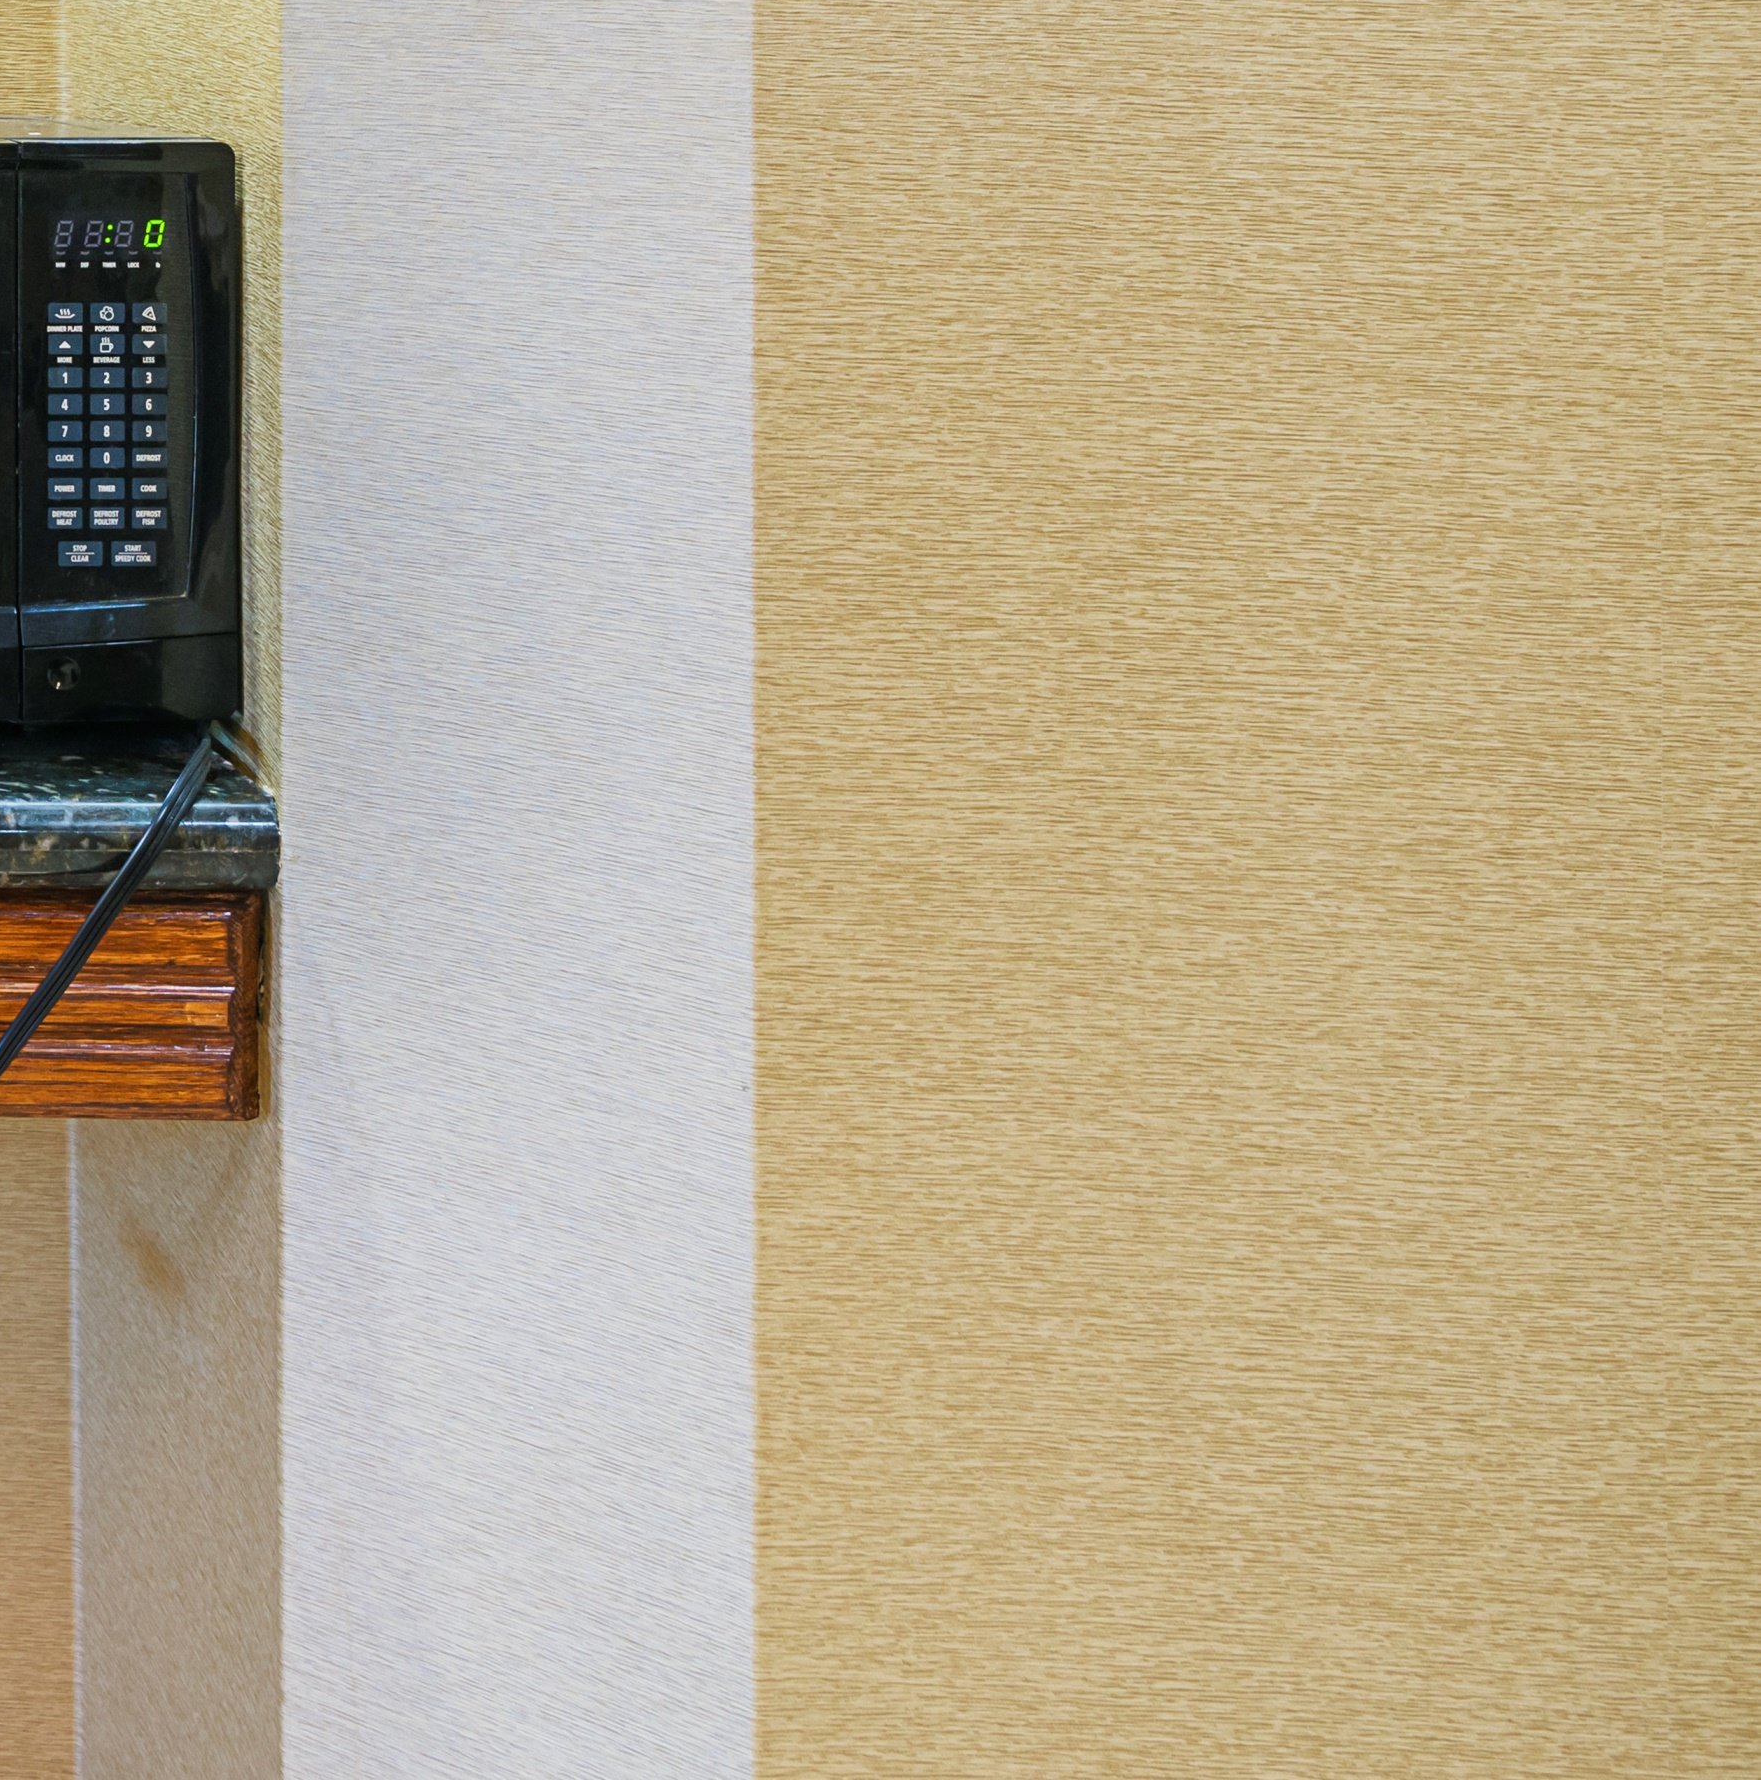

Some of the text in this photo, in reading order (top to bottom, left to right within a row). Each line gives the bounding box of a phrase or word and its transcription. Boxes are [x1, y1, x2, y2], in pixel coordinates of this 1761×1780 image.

[94, 325, 120, 333] POPCORN
[141, 325, 157, 333] PIZZA
[57, 356, 73, 364] MORE
[93, 356, 120, 364] BEVERAGE
[142, 356, 155, 364] LESS
[62, 372, 68, 384] 1
[103, 372, 110, 384] 2
[145, 372, 153, 385] 3
[61, 398, 69, 411] 4
[103, 398, 110, 411] 5
[145, 398, 153, 411] 6
[61, 425, 69, 438] 7
[103, 425, 110, 438] 8
[145, 425, 153, 438] 9
[55, 454, 74, 462] CLOCK
[103, 452, 110, 464] 0
[136, 454, 162, 462] DEFROST
[54, 485, 75, 493] POWER
[98, 485, 116, 493] TIMER
[140, 485, 157, 493] COOK
[51, 510, 77, 518] DEFROST
[94, 510, 119, 518] DEFROST
[136, 510, 162, 518] DEFROST
[56, 518, 73, 526] MEAT
[94, 518, 119, 526] POULTRY
[142, 518, 155, 526] FISH
[72, 544, 87, 552] STOP
[124, 544, 142, 552] START
